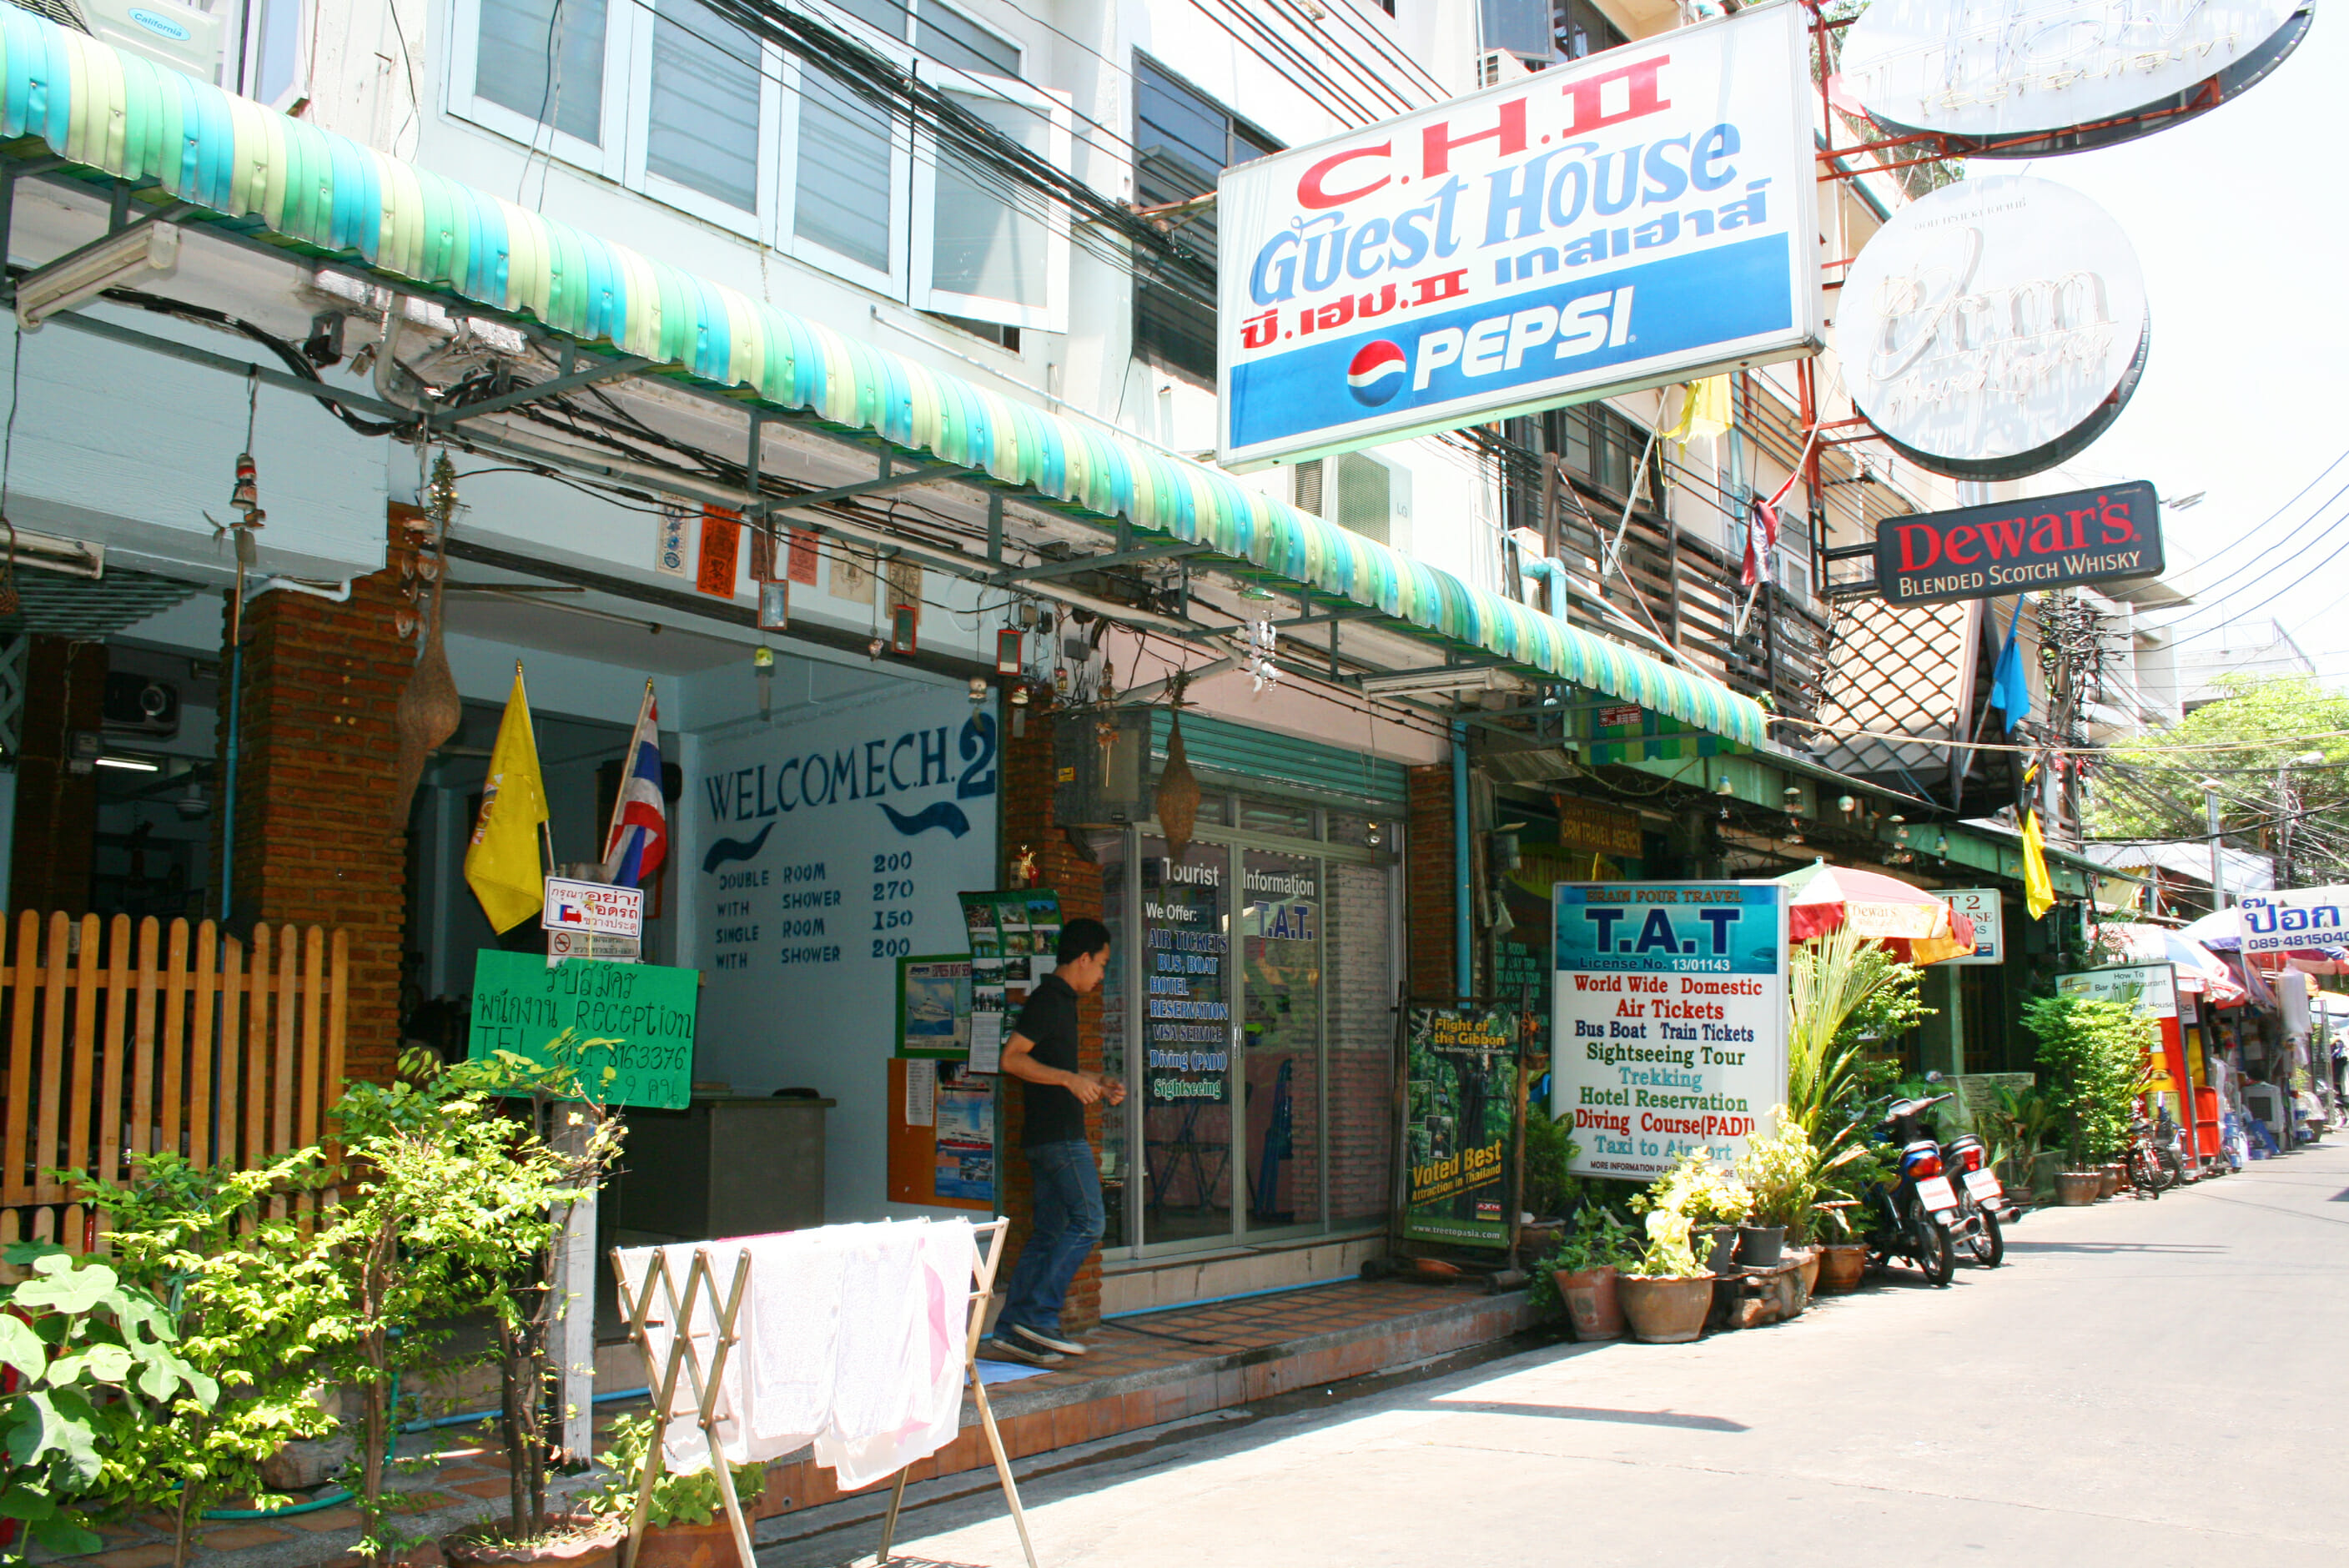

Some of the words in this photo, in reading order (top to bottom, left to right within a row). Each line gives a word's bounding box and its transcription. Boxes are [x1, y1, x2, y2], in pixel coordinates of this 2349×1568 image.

[134, 13, 182, 37] California
[1249, 173, 1470, 307] Guest
[1477, 123, 1741, 249] House
[1412, 285, 1635, 391] PEPSI
[1894, 495, 2135, 572] Dewar's
[1899, 574, 1984, 597] BLENDED
[1989, 560, 2060, 585] SCOTCH
[2064, 550, 2141, 575] WHISKY
[719, 869, 769, 890] DOUBLE
[783, 862, 826, 884] ROOM
[873, 852, 913, 874] 200
[1163, 857, 1219, 887] Tourist
[1243, 868, 1314, 897] Information
[717, 900, 750, 917] WITH
[782, 890, 841, 911] SHOWER
[873, 879, 913, 902] 270
[1636, 890, 1677, 902] FOUR
[1682, 890, 1743, 902] TRAVEL
[1966, 895, 1980, 910] 2
[1146, 902, 1164, 918] We
[1166, 904, 1197, 922] Offer:
[2241, 897, 2341, 934] ป๊อก
[715, 925, 759, 945] SINGLE
[782, 918, 825, 940] ROOM
[873, 910, 913, 931] 150
[1585, 907, 1741, 954] T.A.T
[1148, 928, 1173, 949] AIR
[1175, 931, 1228, 953] TICKETS
[716, 951, 747, 970] WITH
[781, 946, 840, 965] SHOWER
[872, 937, 911, 958] 200
[1579, 957, 1637, 969] License
[1643, 957, 1667, 970] No.
[1672, 958, 1731, 972] 13/01143
[1187, 957, 1218, 975] BOAT
[1149, 976, 1190, 996] HOTEL
[1574, 974, 1622, 993] World
[1627, 975, 1668, 993] Wide
[1680, 977, 1763, 996] Domestic
[2095, 983, 2109, 992] Bar
[1150, 1000, 1228, 1020] RESERVATION
[1616, 999, 1646, 1018] Air
[1651, 999, 1724, 1020] Tickets
[1153, 1025, 1177, 1042] VISA
[1180, 1026, 1222, 1043] SERVICE
[1435, 1018, 1472, 1033] Flight
[1475, 1018, 1489, 1032] of
[1574, 1020, 1605, 1038] Bus
[1610, 1021, 1647, 1039] Boat
[1660, 1023, 1697, 1041] Train
[1701, 1023, 1754, 1043] Tickets
[1435, 1032, 1455, 1044] the
[1458, 1033, 1506, 1046] Gibbon
[1150, 1049, 1189, 1072] Diving
[1191, 1050, 1228, 1073] (PADI)
[1587, 1042, 1694, 1068] Sightseeing
[1701, 1047, 1746, 1066] Tour
[1154, 1078, 1222, 1101] Sightseeing
[1618, 1066, 1703, 1093] Trekking
[1579, 1086, 1630, 1107] Hotel
[1635, 1088, 1748, 1113] Reservation
[1575, 1108, 1631, 1136] Diving
[1594, 1133, 1633, 1155] Taxi
[1640, 1137, 1659, 1157] to
[1664, 1140, 1733, 1162] Airort
[1413, 1151, 1460, 1188] Voted
[1464, 1138, 1501, 1171] Best
[1590, 1161, 1609, 1170] MORE
[1610, 1162, 1655, 1173] INFORMATION
[1411, 1179, 1454, 1202] Attraction
[1455, 1176, 1464, 1188] in
[1466, 1162, 1501, 1184] Thailand
[1411, 1224, 1501, 1239] www.treetopasia.com
